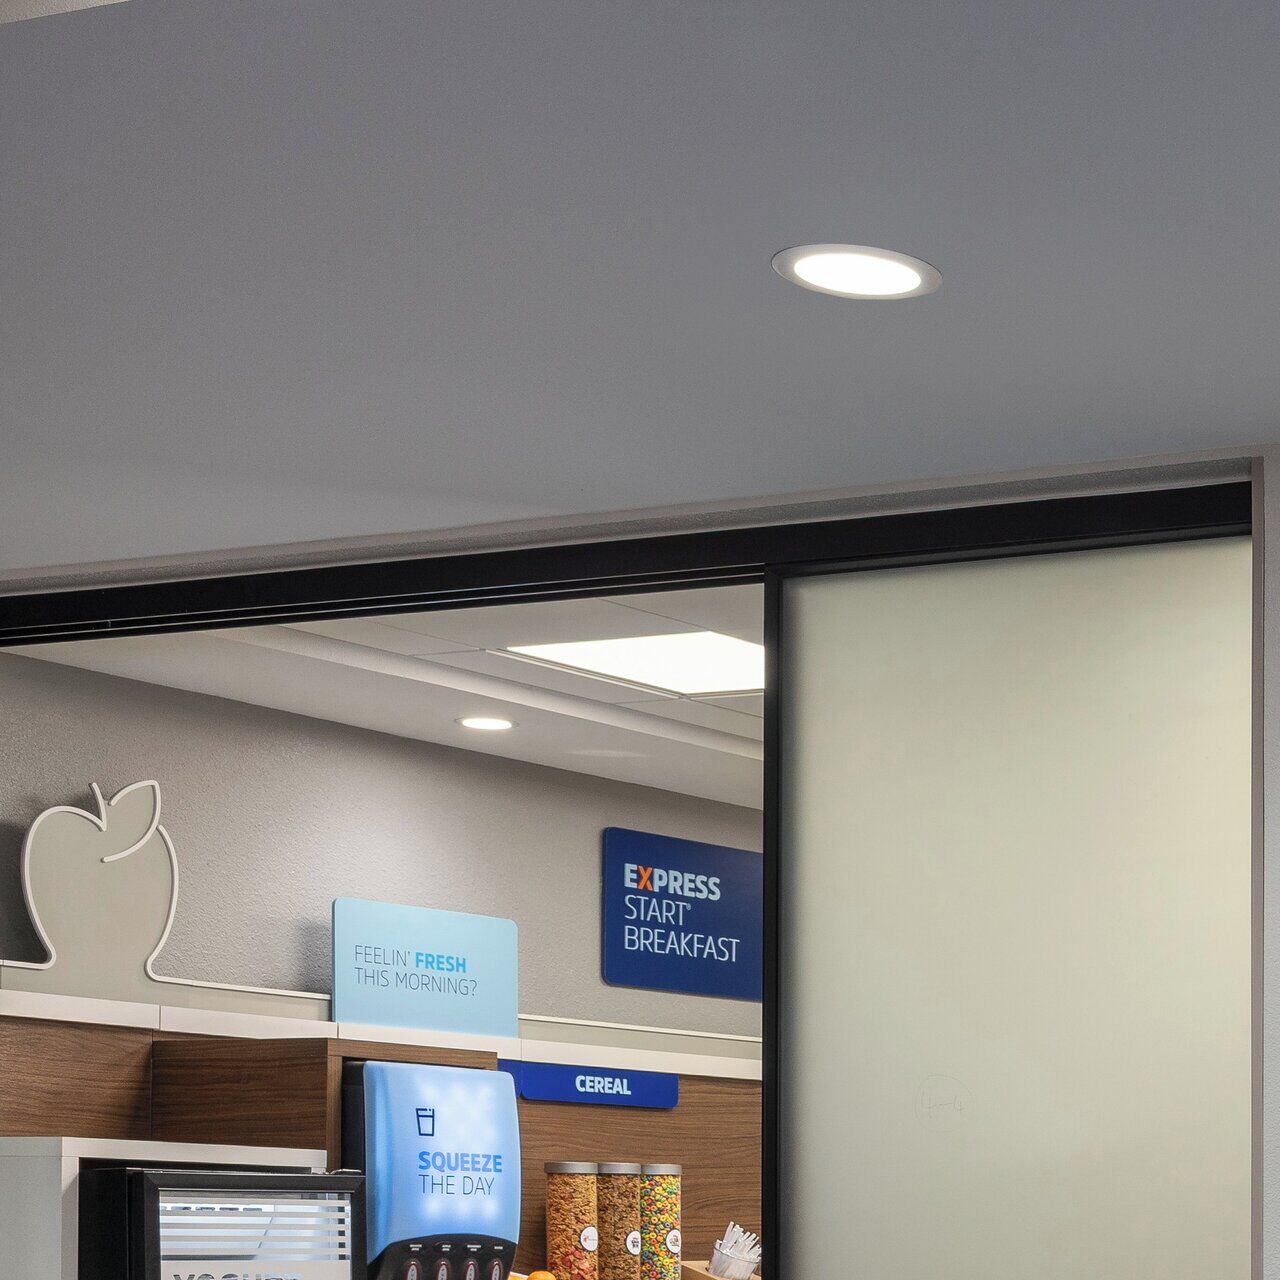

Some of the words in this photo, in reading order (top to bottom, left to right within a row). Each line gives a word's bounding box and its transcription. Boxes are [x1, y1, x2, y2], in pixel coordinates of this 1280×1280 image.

[624, 863, 721, 901] EXPRESS
[624, 925, 741, 962] BREAKFAST
[354, 944, 411, 967] FEELIN'
[415, 951, 467, 973] FRESH
[354, 967, 390, 988] THIS
[395, 971, 478, 997] MORNING?
[575, 1075, 632, 1096] CEREAL
[418, 1151, 503, 1173] SQUEEZE
[418, 1173, 455, 1195] THE
[462, 1175, 495, 1196] DAY
